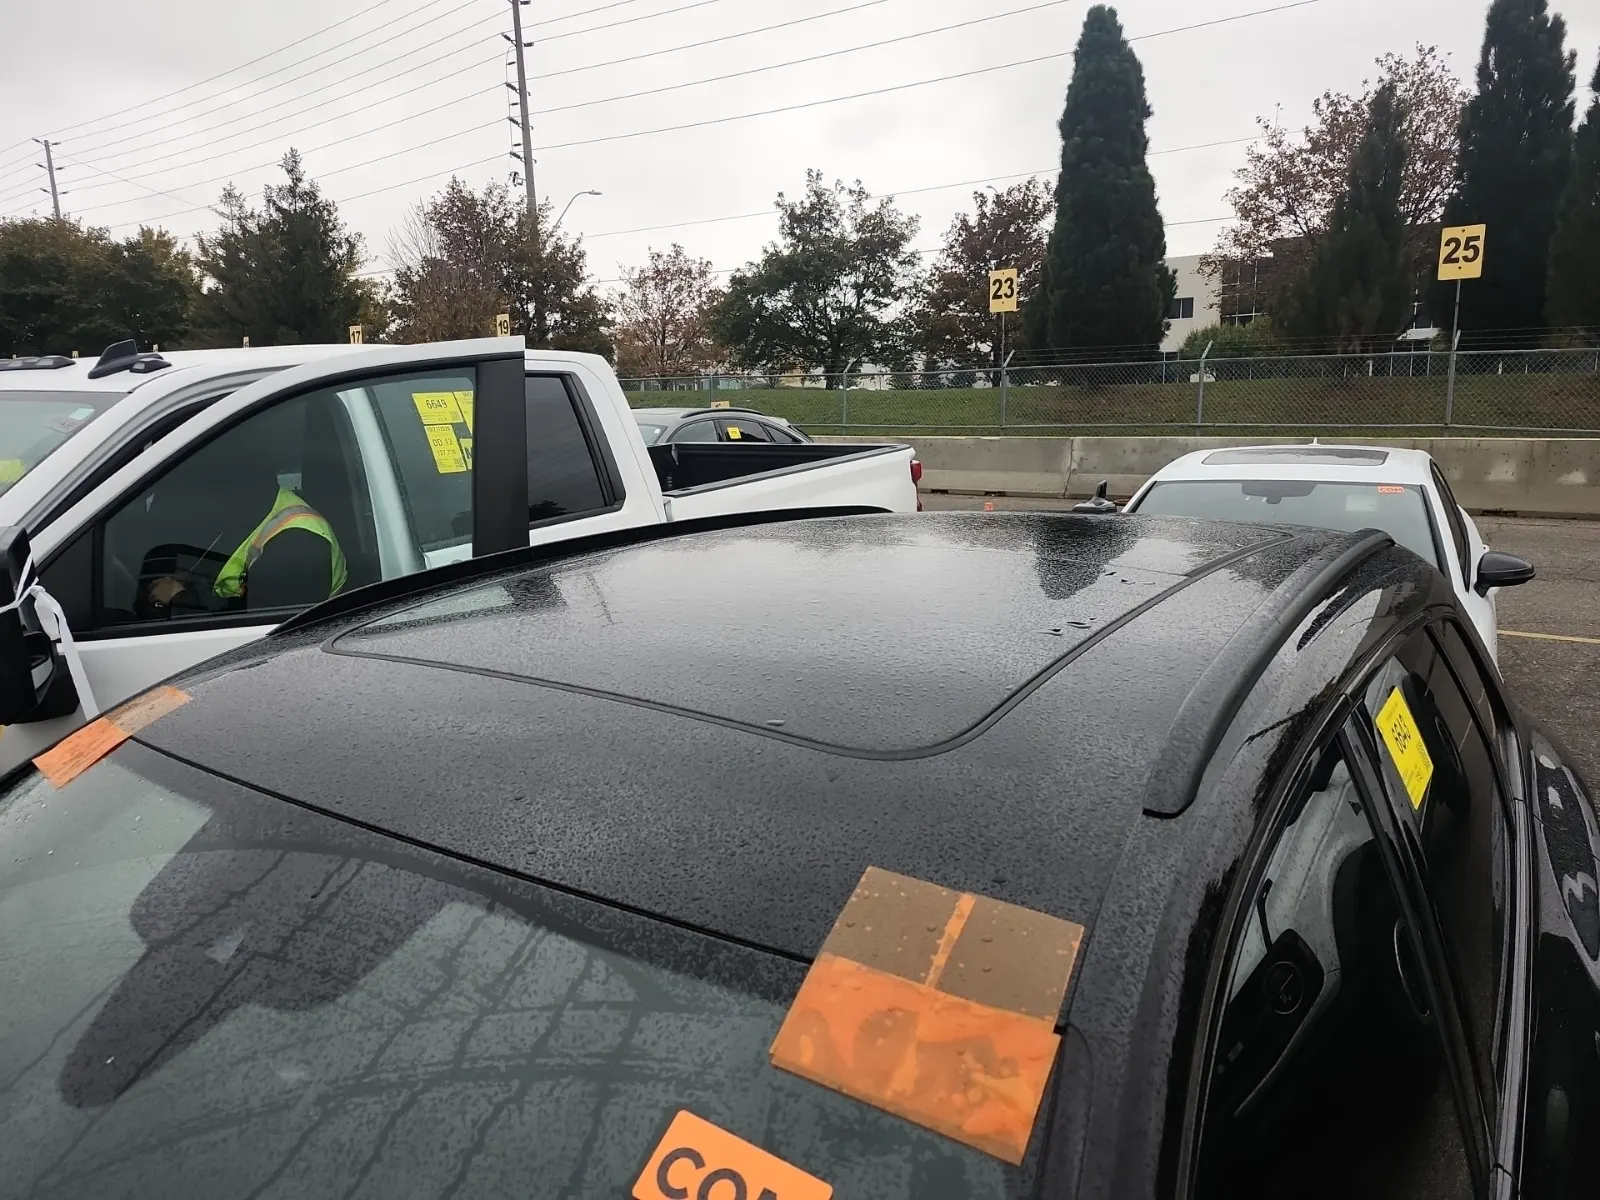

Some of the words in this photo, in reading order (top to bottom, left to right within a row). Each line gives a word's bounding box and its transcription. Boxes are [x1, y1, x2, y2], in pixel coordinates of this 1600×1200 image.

[1442, 235, 1481, 264] 25
[992, 277, 1014, 300] 23
[351, 330, 361, 343] 17
[498, 319, 509, 335] 19
[425, 399, 448, 409] 6649
[1391, 713, 1411, 755] 6643
[656, 1147, 778, 1200] CO
